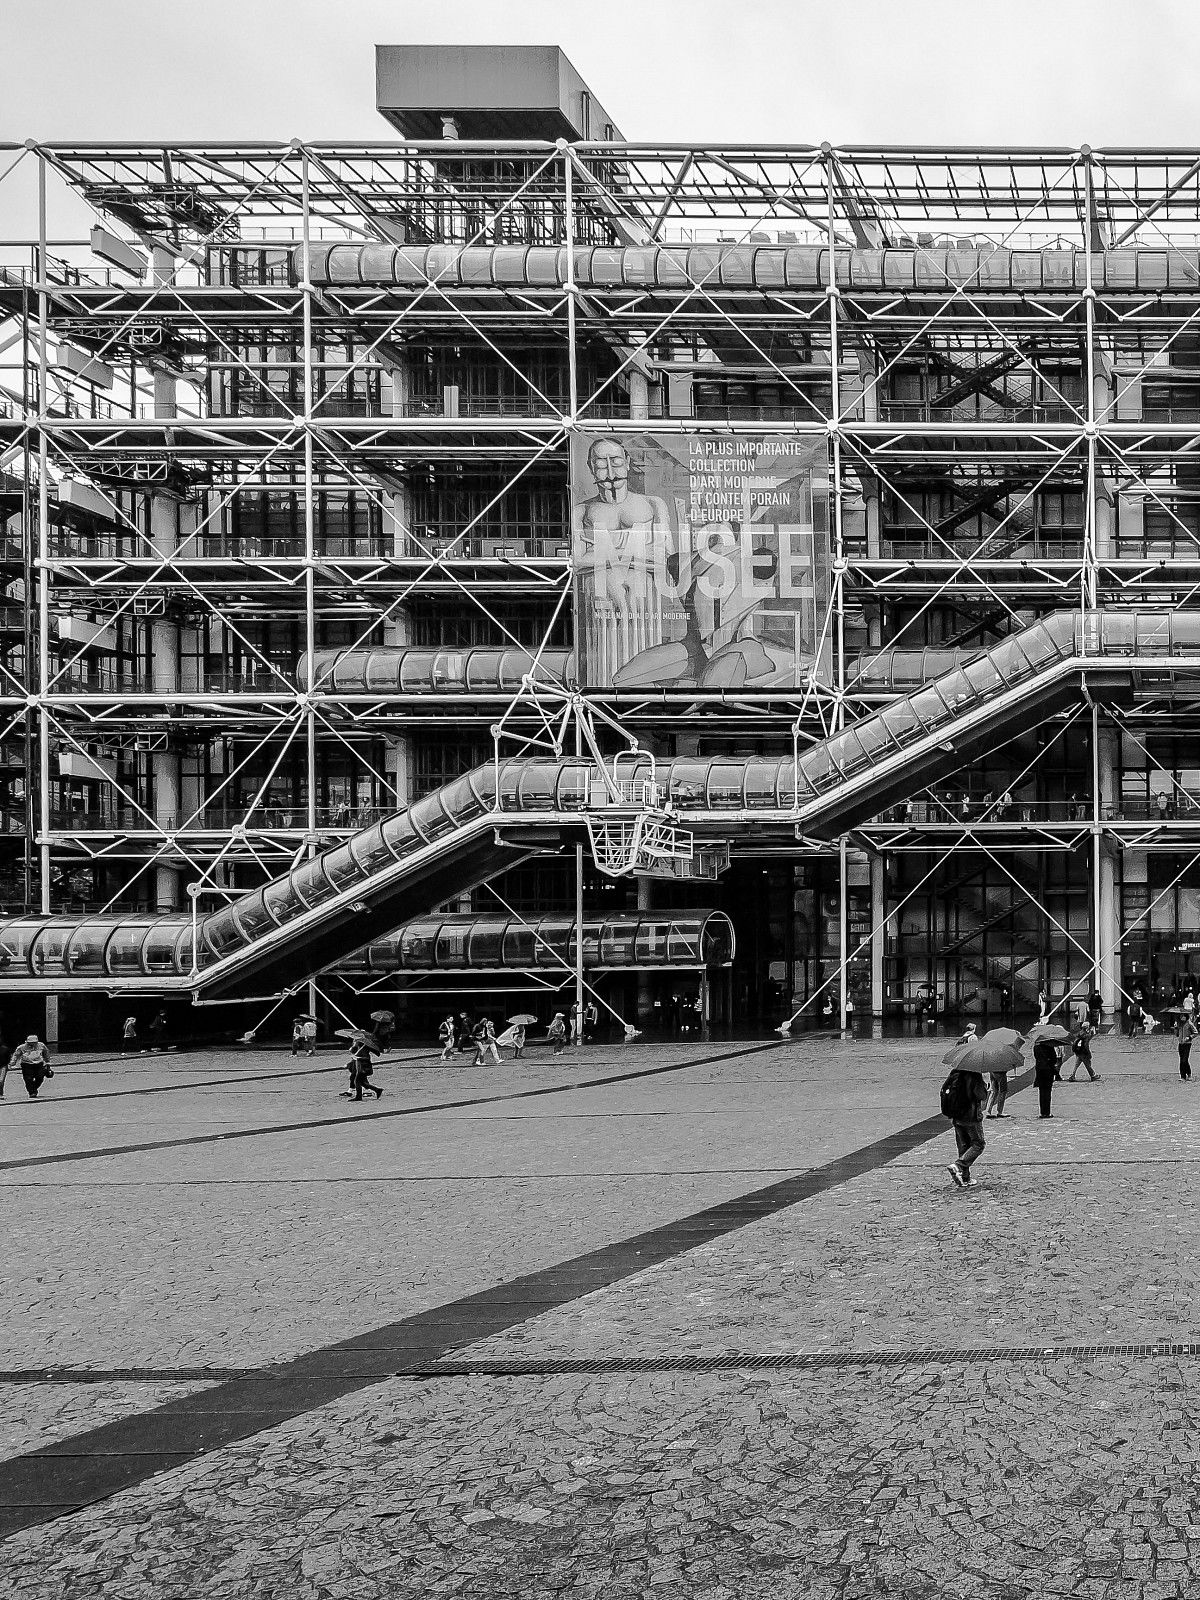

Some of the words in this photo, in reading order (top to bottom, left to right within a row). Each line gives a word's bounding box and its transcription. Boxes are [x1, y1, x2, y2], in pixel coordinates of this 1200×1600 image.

[689, 441, 703, 455] LA
[705, 441, 733, 456] PLUS
[736, 441, 802, 456] IMPORTANTE
[689, 458, 755, 472] COLLECTION
[689, 474, 721, 489] D'ART
[690, 491, 703, 505] ET
[705, 492, 790, 506] CONTEPORAIN
[690, 508, 744, 522] D'EUROPE
[594, 505, 814, 599] MUSÉE
[662, 612, 691, 620] MODERNE
